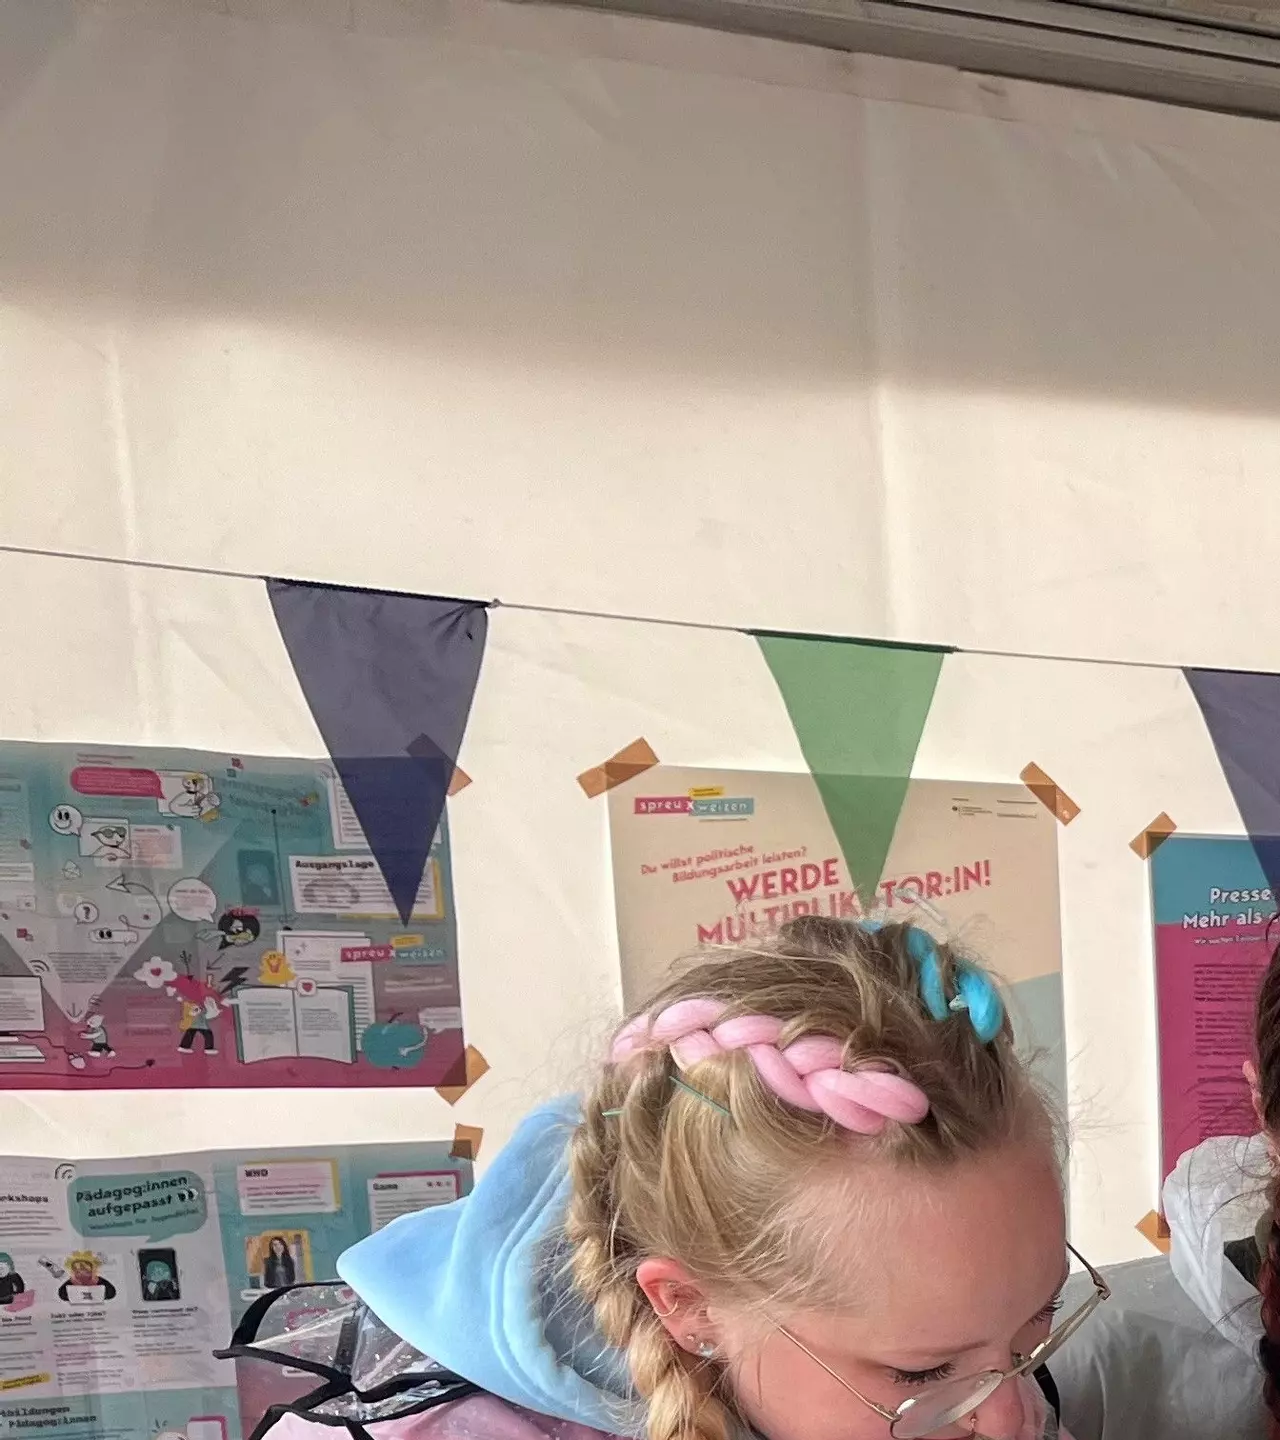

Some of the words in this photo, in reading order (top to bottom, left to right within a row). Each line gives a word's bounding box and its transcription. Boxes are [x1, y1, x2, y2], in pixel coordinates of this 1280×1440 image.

[639, 801, 680, 815] spreu
[698, 801, 749, 814] weizen
[672, 855, 759, 884] Bildungsarbeit
[762, 846, 808, 865] leisten?
[696, 843, 755, 865] politische
[726, 858, 841, 905] WERDE
[1209, 887, 1273, 904] Presse
[1182, 909, 1230, 929] Mehr
[1236, 907, 1262, 926] als
[76, 1175, 189, 1204] Pädagog:innen
[88, 1193, 173, 1218] aufgepasst
